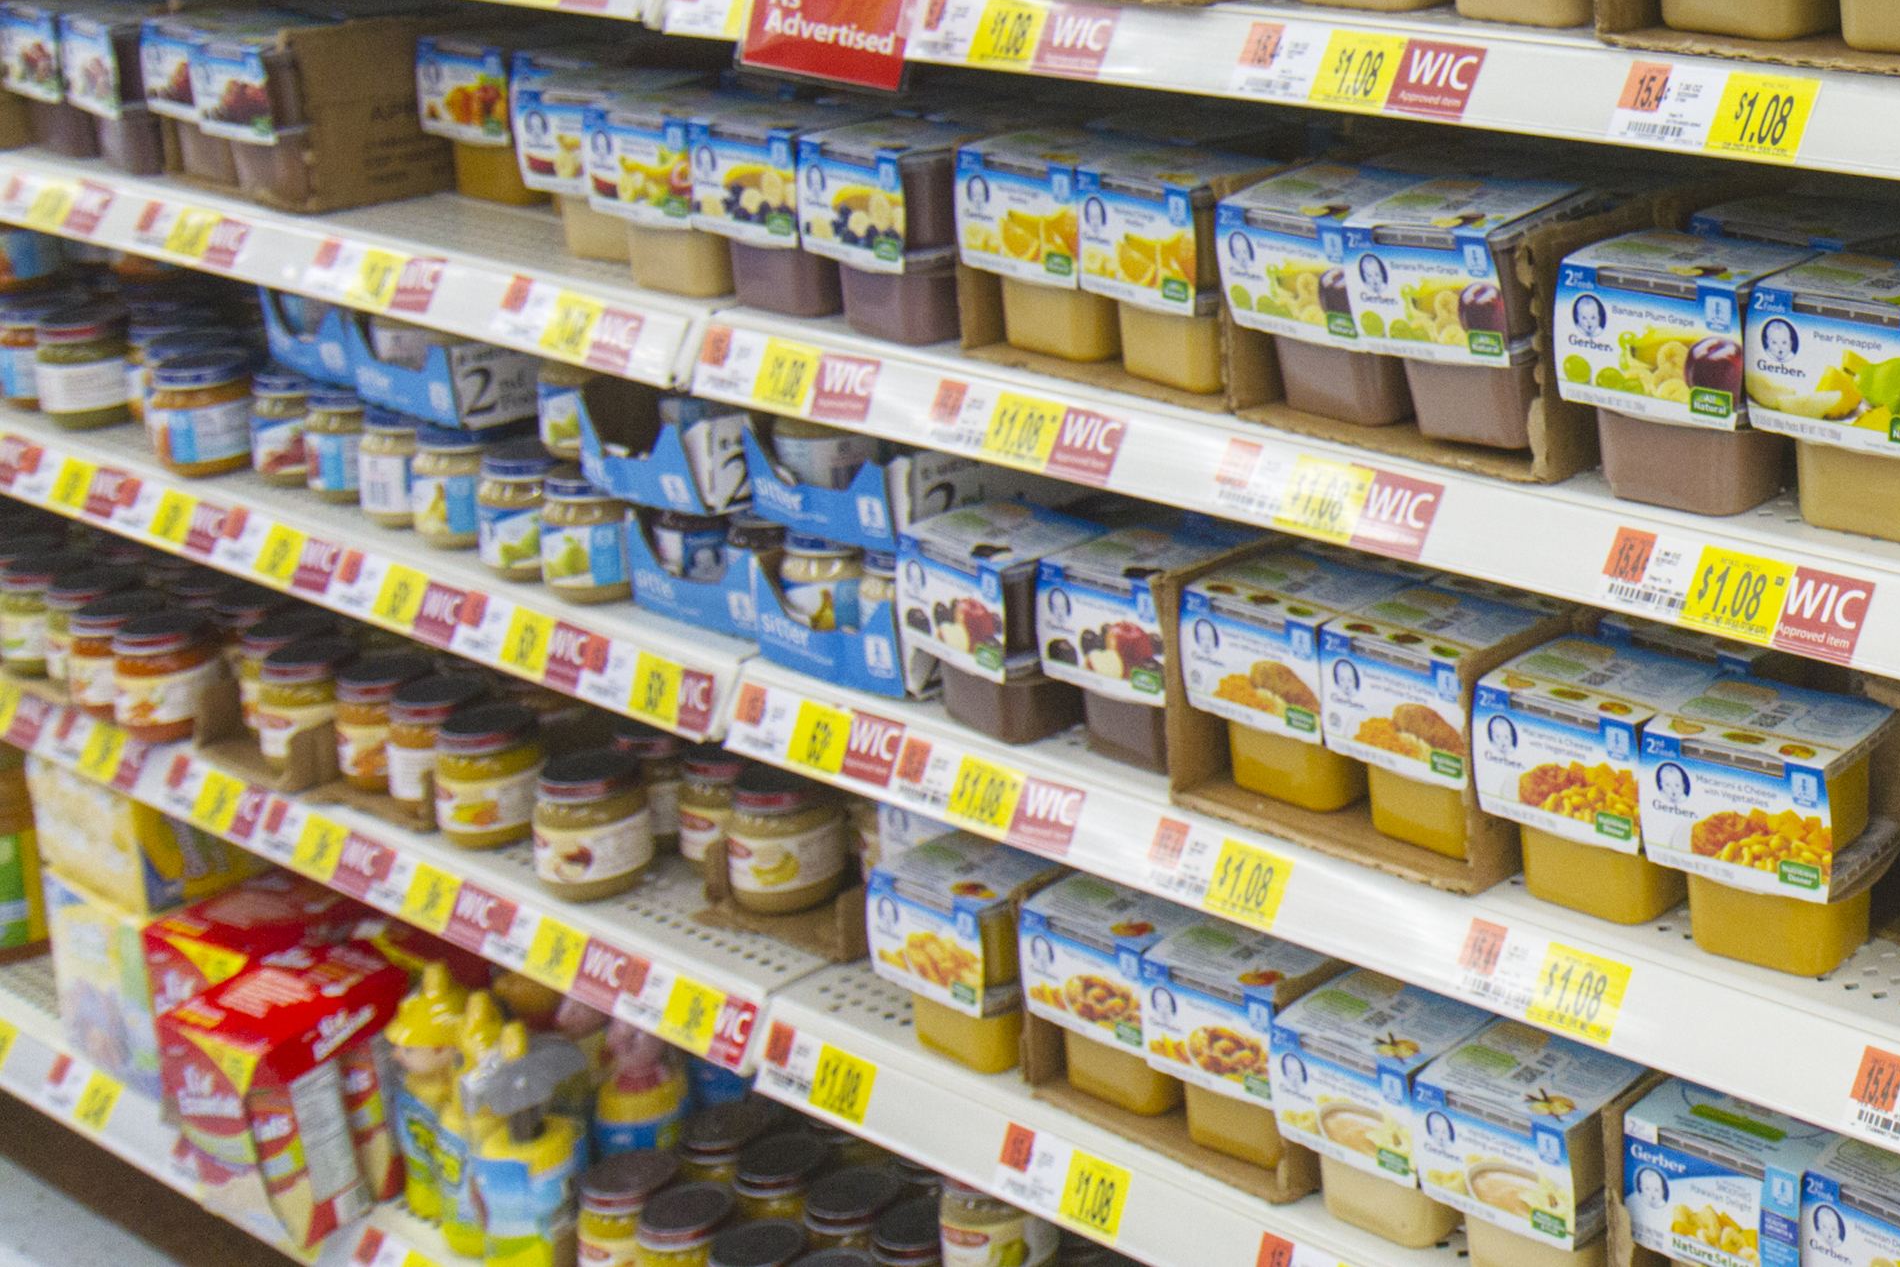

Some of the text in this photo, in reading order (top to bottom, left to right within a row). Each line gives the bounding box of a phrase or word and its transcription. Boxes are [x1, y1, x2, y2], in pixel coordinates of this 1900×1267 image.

[764, 10, 895, 55] Advertised
[1051, 15, 1112, 50] WIC
[1335, 48, 1385, 98] $1.08
[1611, 304, 1695, 328] Banana Plum Grape
[1812, 331, 1882, 351] Pear Pineapple
[459, 369, 494, 420] 2
[1692, 399, 1727, 415] Natural
[1064, 418, 1115, 455] WIC
[754, 476, 806, 506] sitter
[1366, 484, 1434, 526] WIC
[1785, 576, 1867, 631] WIC
[761, 610, 809, 645] sitter
[850, 718, 897, 760] WIC
[1695, 773, 1778, 797] Macaroni Cheese
[1026, 790, 1078, 825] WIC
[1218, 859, 1272, 908] $1.08
[1543, 968, 1608, 1022] $1.08
[1630, 1144, 1687, 1175] Gerber
[1075, 1167, 1115, 1224] $1.08
